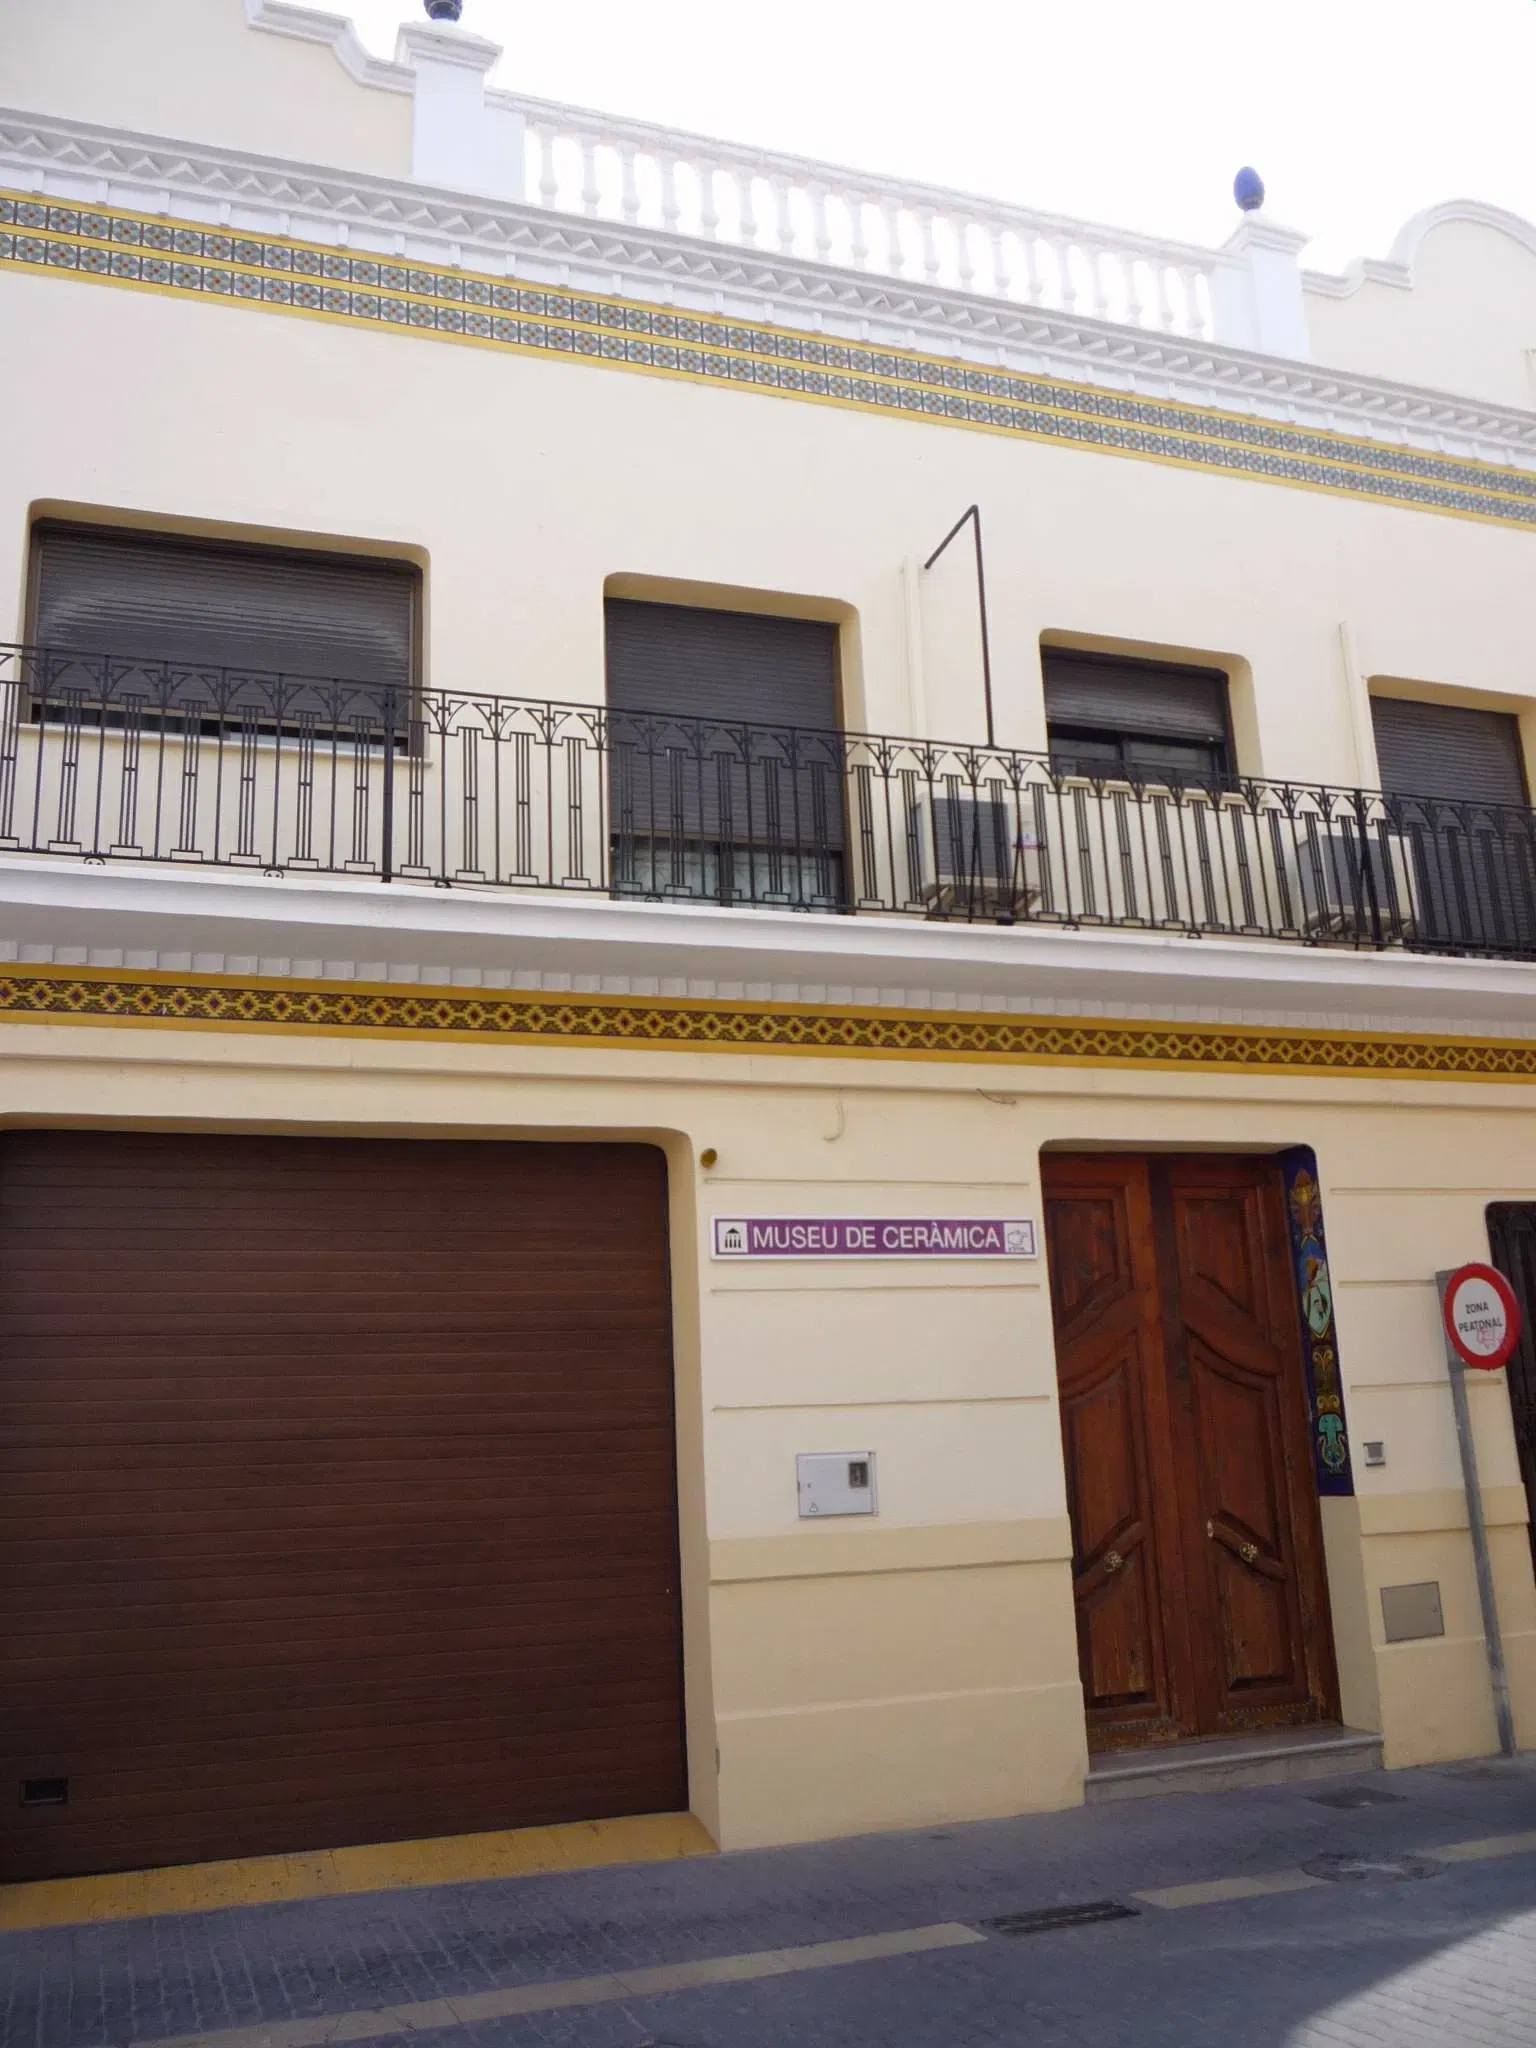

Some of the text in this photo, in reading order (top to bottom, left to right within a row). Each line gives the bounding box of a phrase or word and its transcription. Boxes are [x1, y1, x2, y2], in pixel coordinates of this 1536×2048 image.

[753, 1221, 1001, 1249] MUSEU DE CERÀMICA
[1465, 1301, 1489, 1314] ZONA
[1459, 1317, 1503, 1332] PEATONAL
